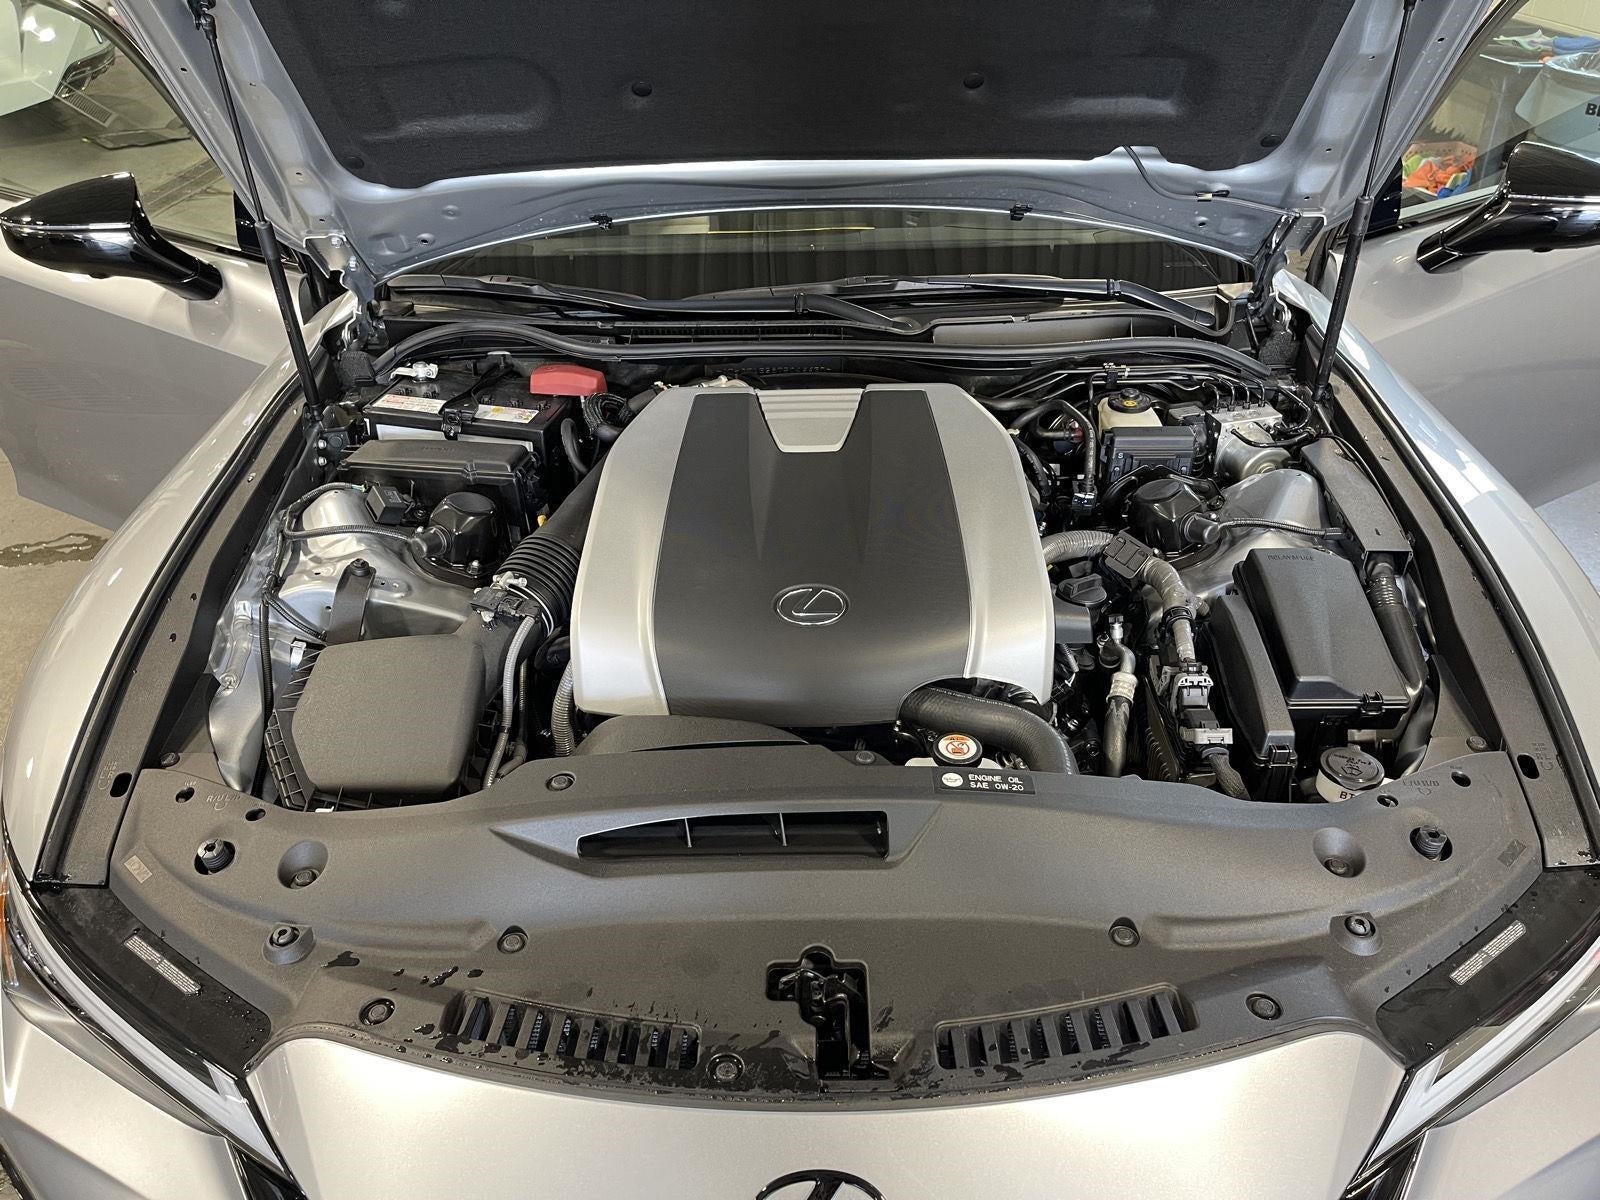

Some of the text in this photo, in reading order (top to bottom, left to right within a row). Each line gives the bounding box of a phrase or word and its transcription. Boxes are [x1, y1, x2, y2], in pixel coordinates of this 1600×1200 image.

[1585, 102, 1600, 117] B
[968, 773, 1023, 784] ENGINE OIL
[970, 782, 989, 790] SAE
